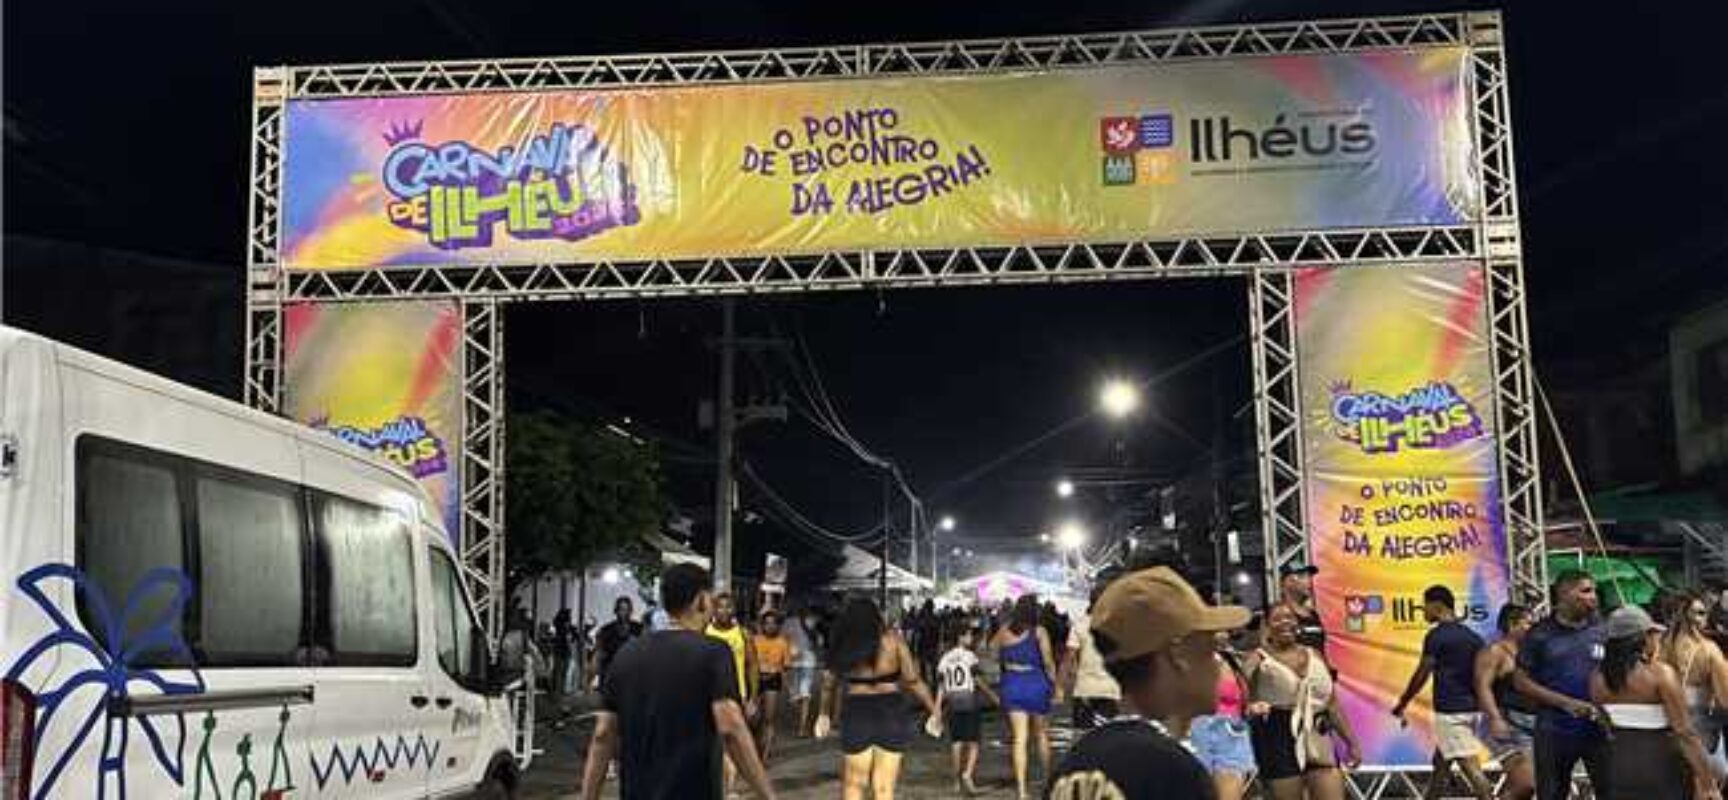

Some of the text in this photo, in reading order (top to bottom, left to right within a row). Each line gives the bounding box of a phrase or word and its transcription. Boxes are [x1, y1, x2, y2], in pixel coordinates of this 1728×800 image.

[773, 108, 898, 149] O PONTO
[1190, 113, 1376, 162] Ilhéus
[740, 135, 939, 176] DE ENCONTRO
[790, 143, 991, 216] DA ALEGRIA!
[389, 197, 428, 225] DE
[1360, 476, 1447, 500] O PONTO
[1340, 499, 1477, 526] DE ENCONTRO
[1343, 522, 1482, 560] DA ALEGRIA!
[946, 664, 966, 687] 10
